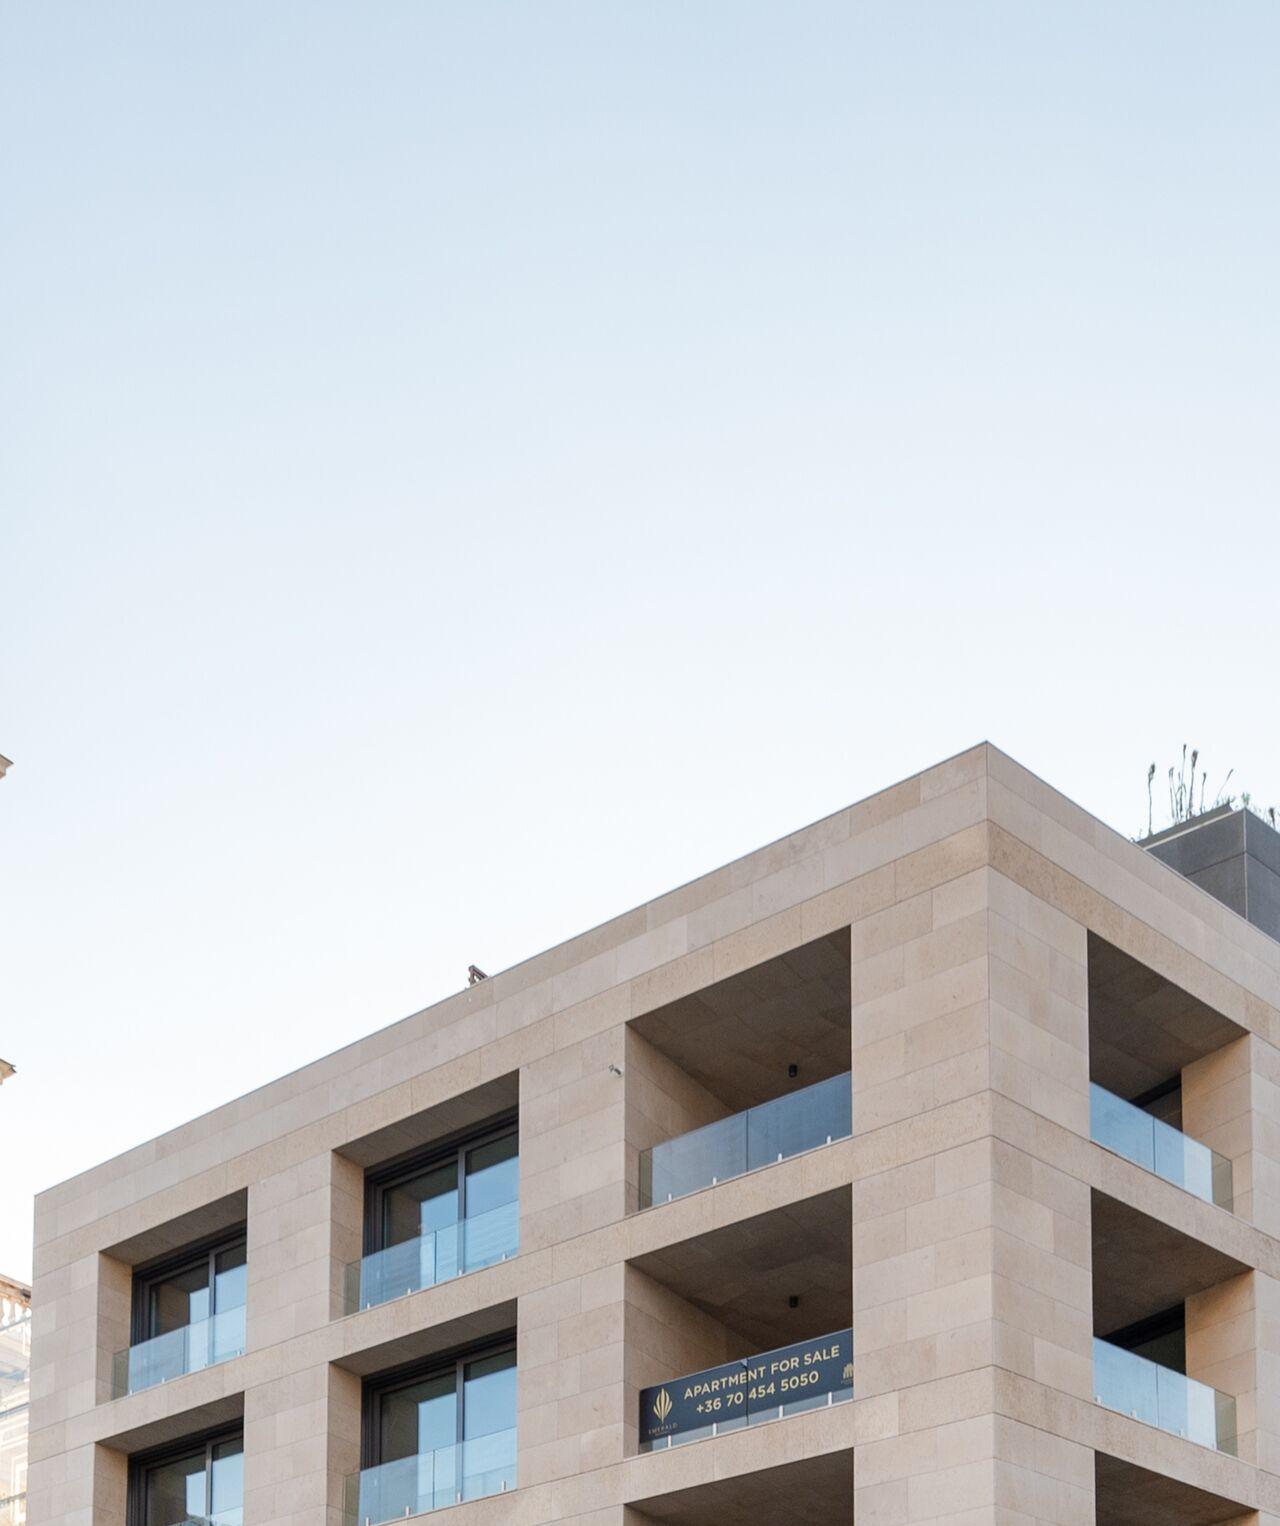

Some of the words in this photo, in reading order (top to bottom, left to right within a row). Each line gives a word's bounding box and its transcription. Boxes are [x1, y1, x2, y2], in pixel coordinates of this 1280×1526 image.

[684, 1366, 766, 1400] APARTMENT
[771, 1357, 800, 1375] FOR
[804, 1345, 841, 1366] SALE
[696, 1398, 722, 1414] +36
[726, 1392, 744, 1407] 70
[748, 1382, 776, 1401] 454
[780, 1371, 819, 1391] 5050
